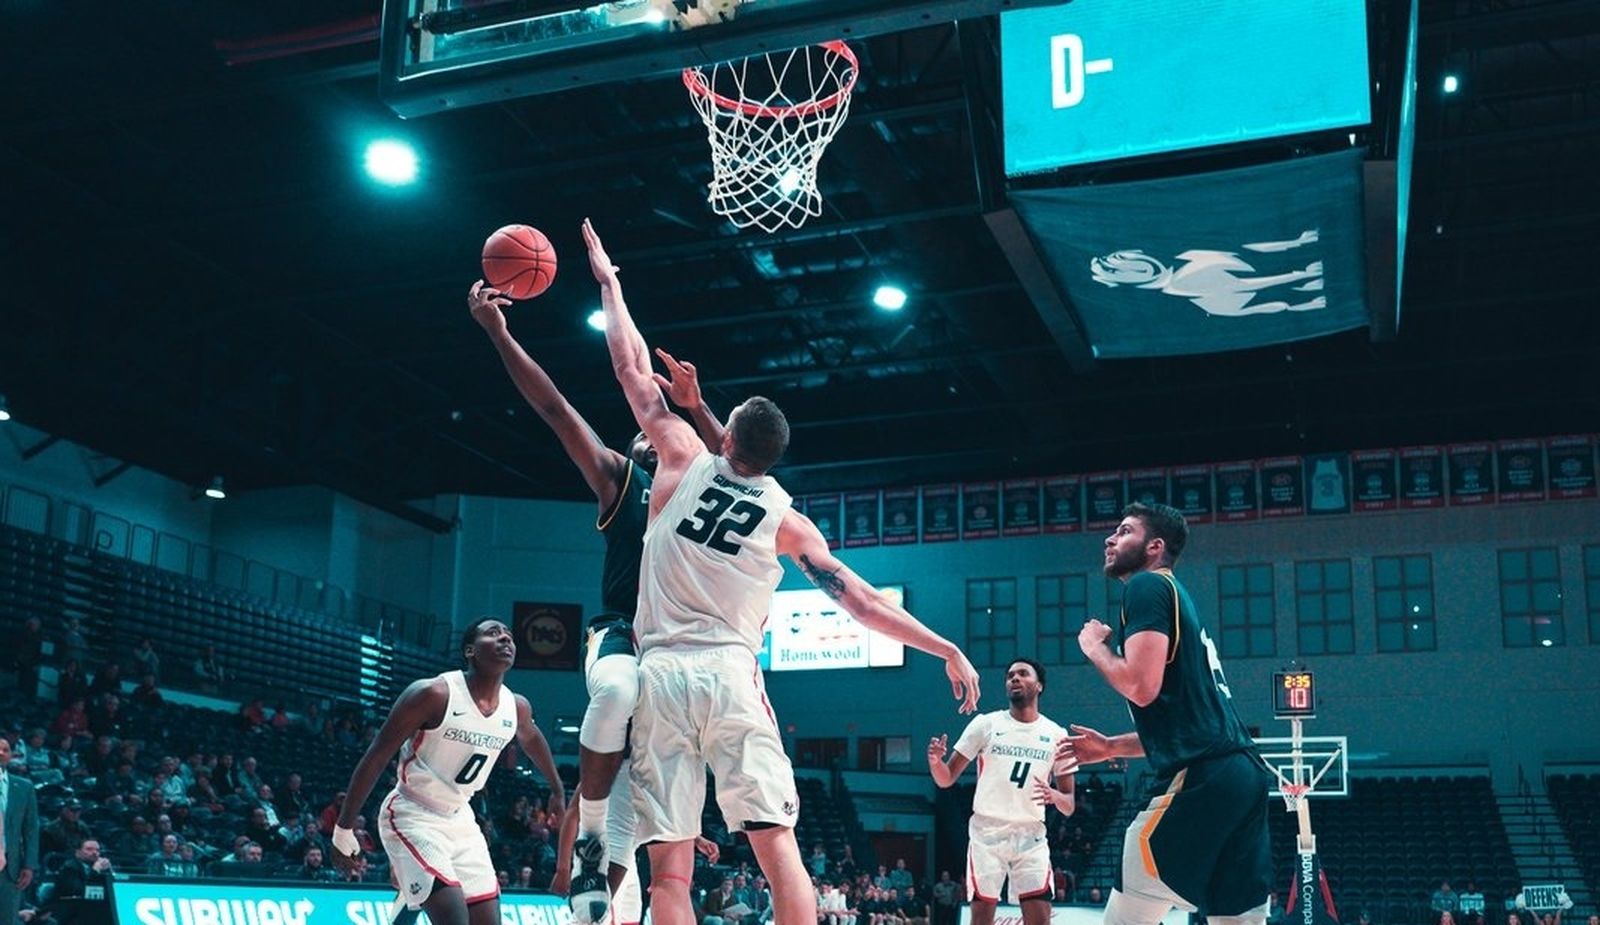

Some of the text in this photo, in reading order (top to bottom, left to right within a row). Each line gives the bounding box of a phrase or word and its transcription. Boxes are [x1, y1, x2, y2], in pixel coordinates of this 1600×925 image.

[1051, 33, 1114, 110] D-
[676, 487, 767, 556] 32
[1284, 675, 1311, 688] 2:35
[1290, 688, 1307, 708] 10
[454, 753, 488, 784] 0
[1010, 761, 1031, 789] 4
[1525, 886, 1563, 907] DEFENS
[135, 897, 315, 925] SUBWAY
